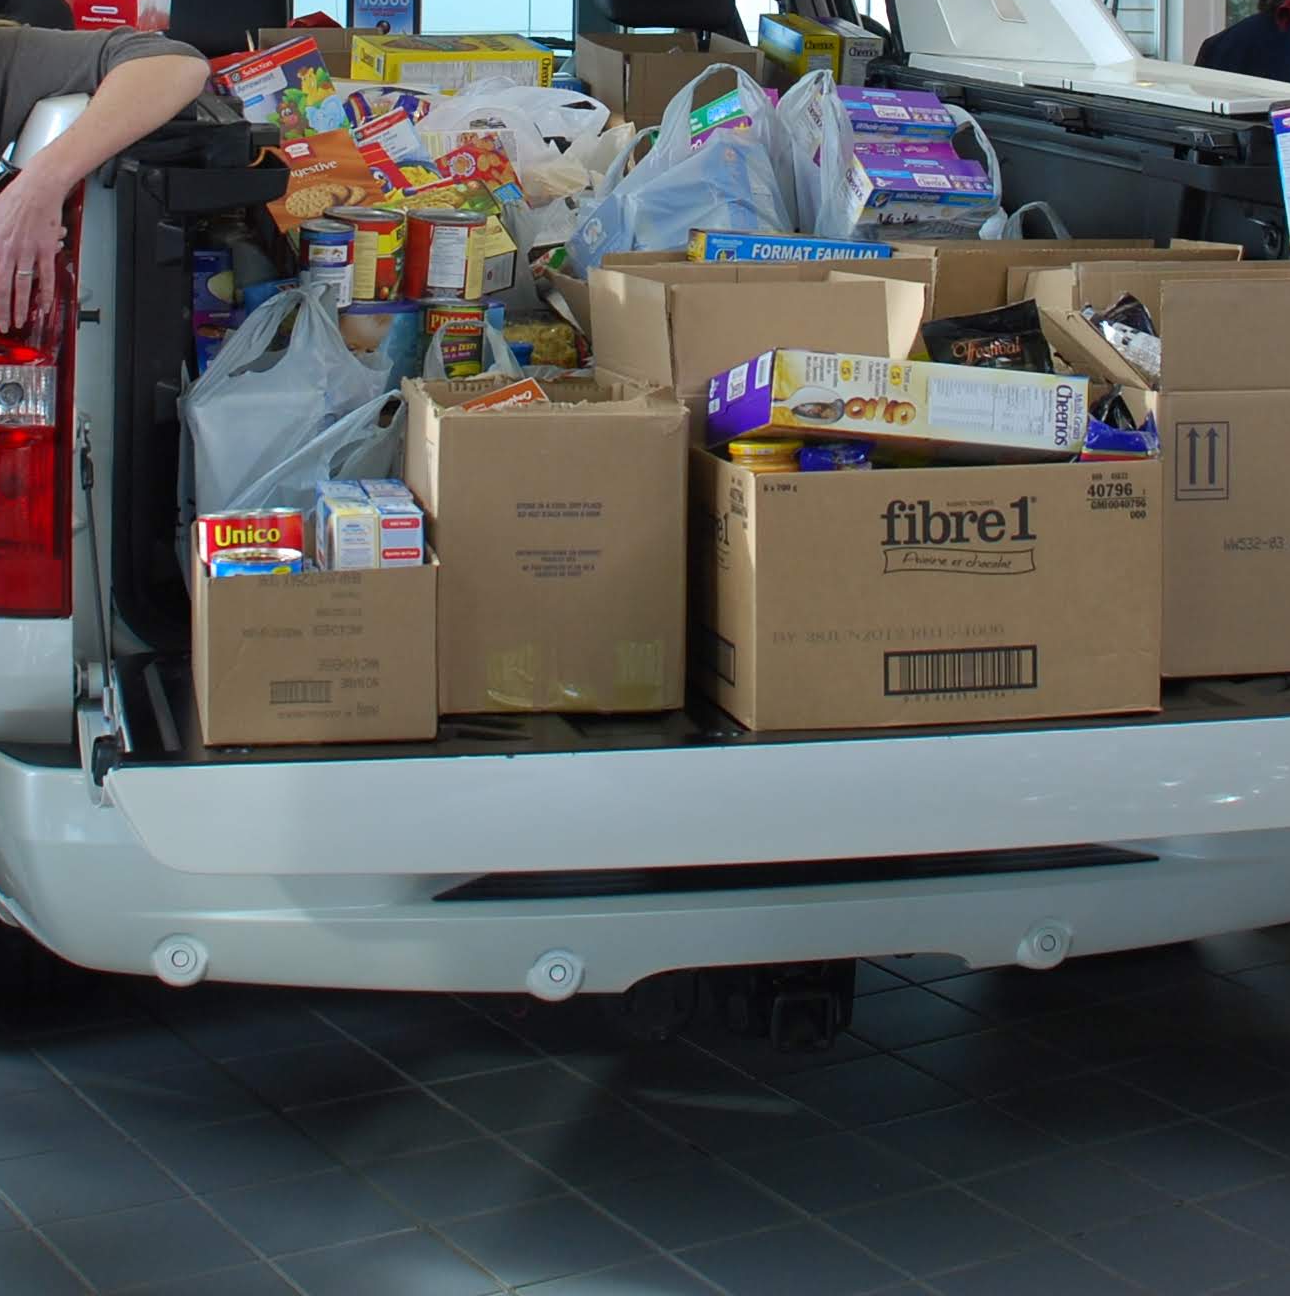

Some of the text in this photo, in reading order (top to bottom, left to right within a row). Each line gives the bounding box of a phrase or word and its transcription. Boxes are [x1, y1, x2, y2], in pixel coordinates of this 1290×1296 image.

[752, 244, 813, 260] FORMAT
[1055, 384, 1073, 447] Cheerios
[1087, 482, 1133, 497] 40796
[214, 524, 281, 547] Unico
